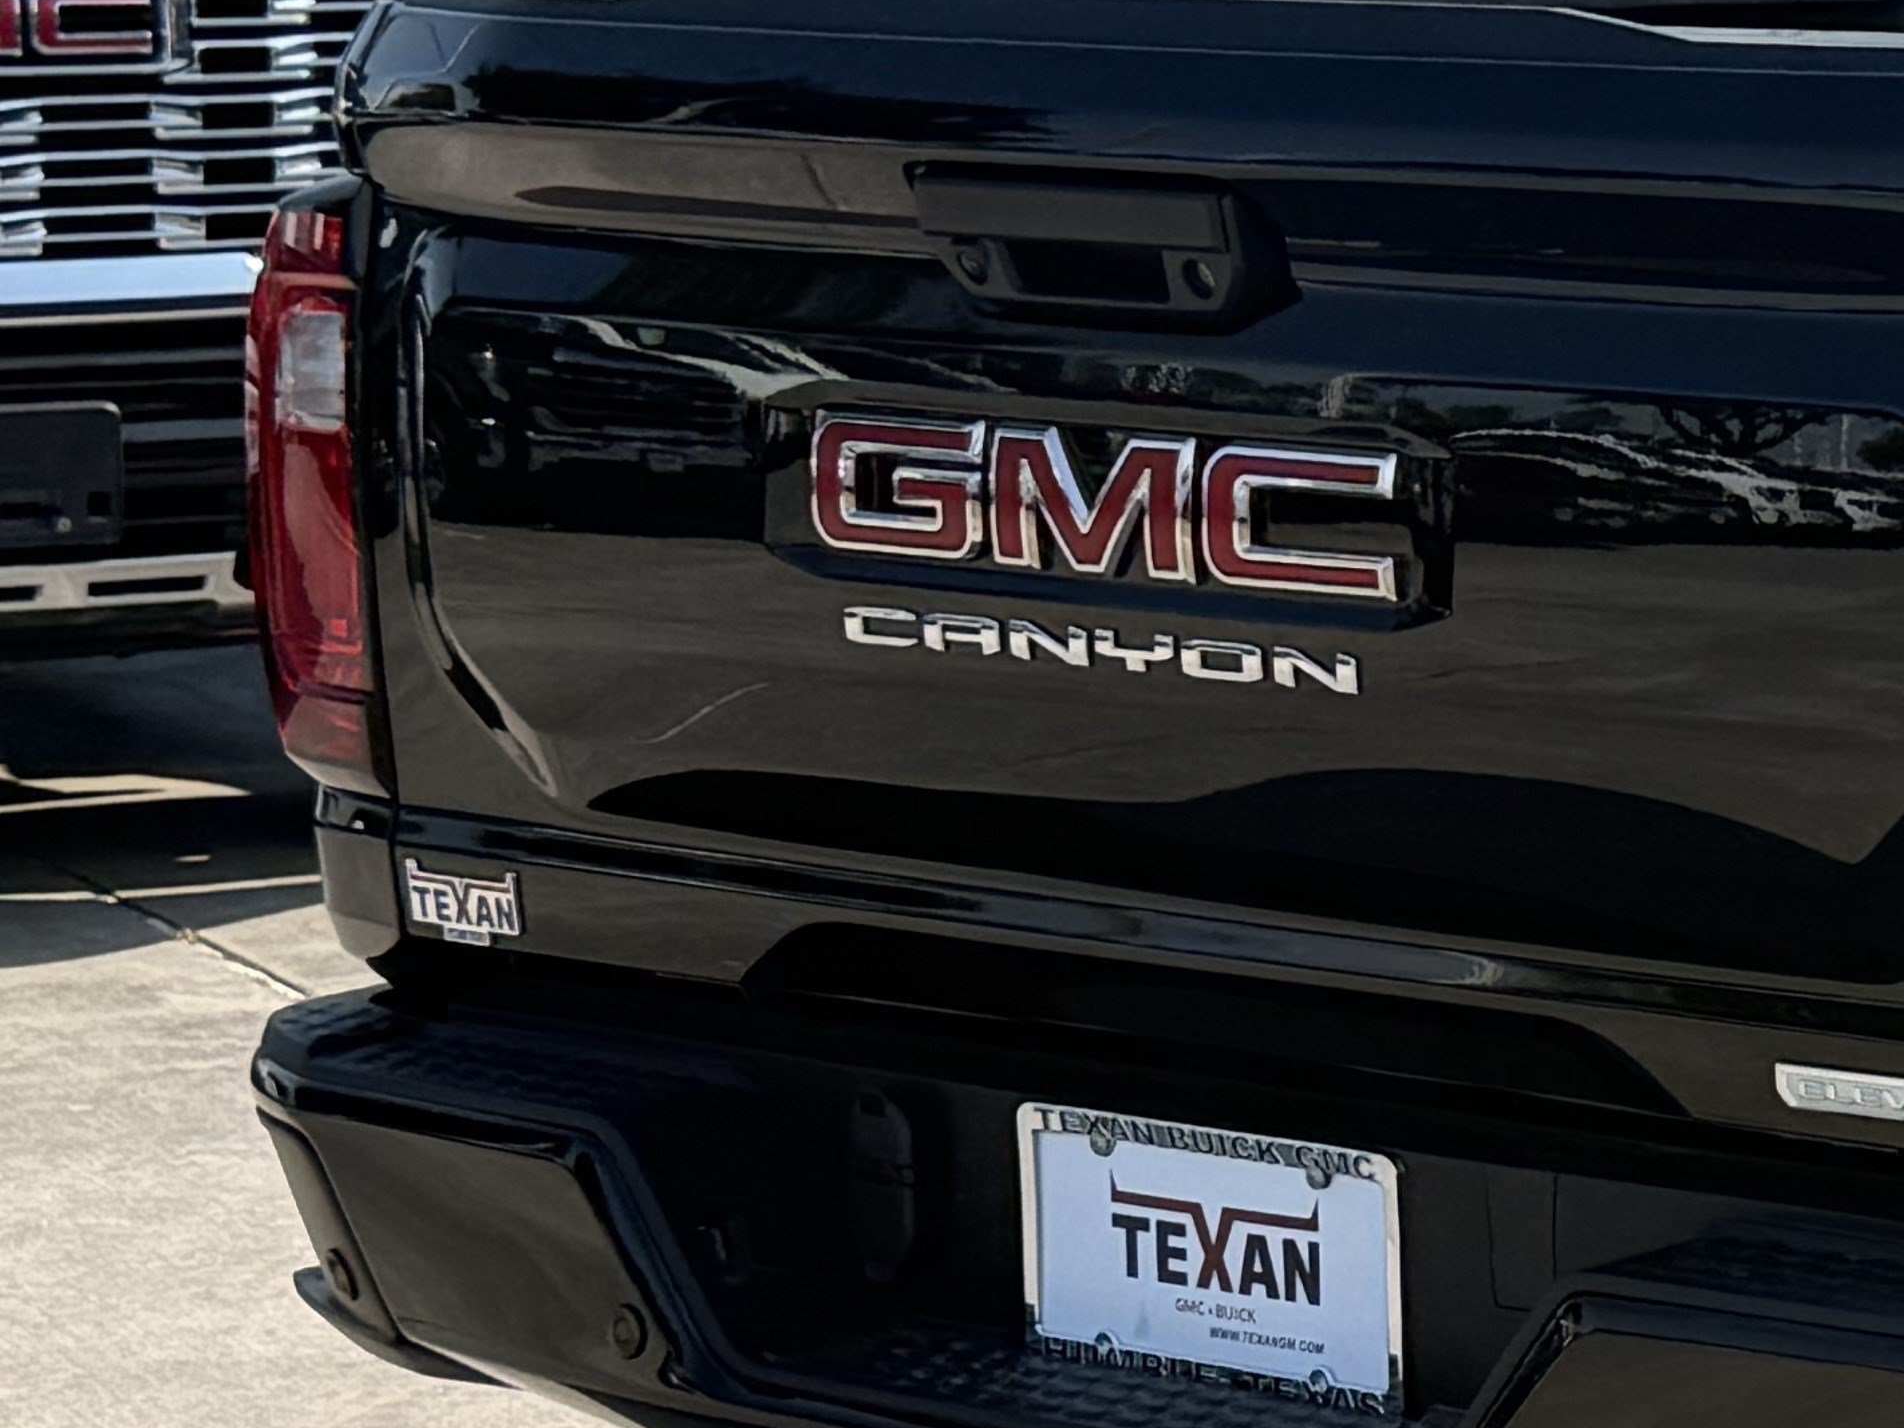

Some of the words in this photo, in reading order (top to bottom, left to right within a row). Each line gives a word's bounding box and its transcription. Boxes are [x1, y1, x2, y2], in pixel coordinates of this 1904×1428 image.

[810, 418, 1398, 601] GMC
[844, 605, 1359, 695] CANYON
[410, 874, 516, 932] TEXAN
[1034, 1107, 1152, 1145] TEXAN
[1168, 1125, 1281, 1165] BUICK
[1294, 1145, 1376, 1180] GMC
[1110, 1190, 1321, 1307] TEXAN
[1215, 1303, 1257, 1324] BUICK
